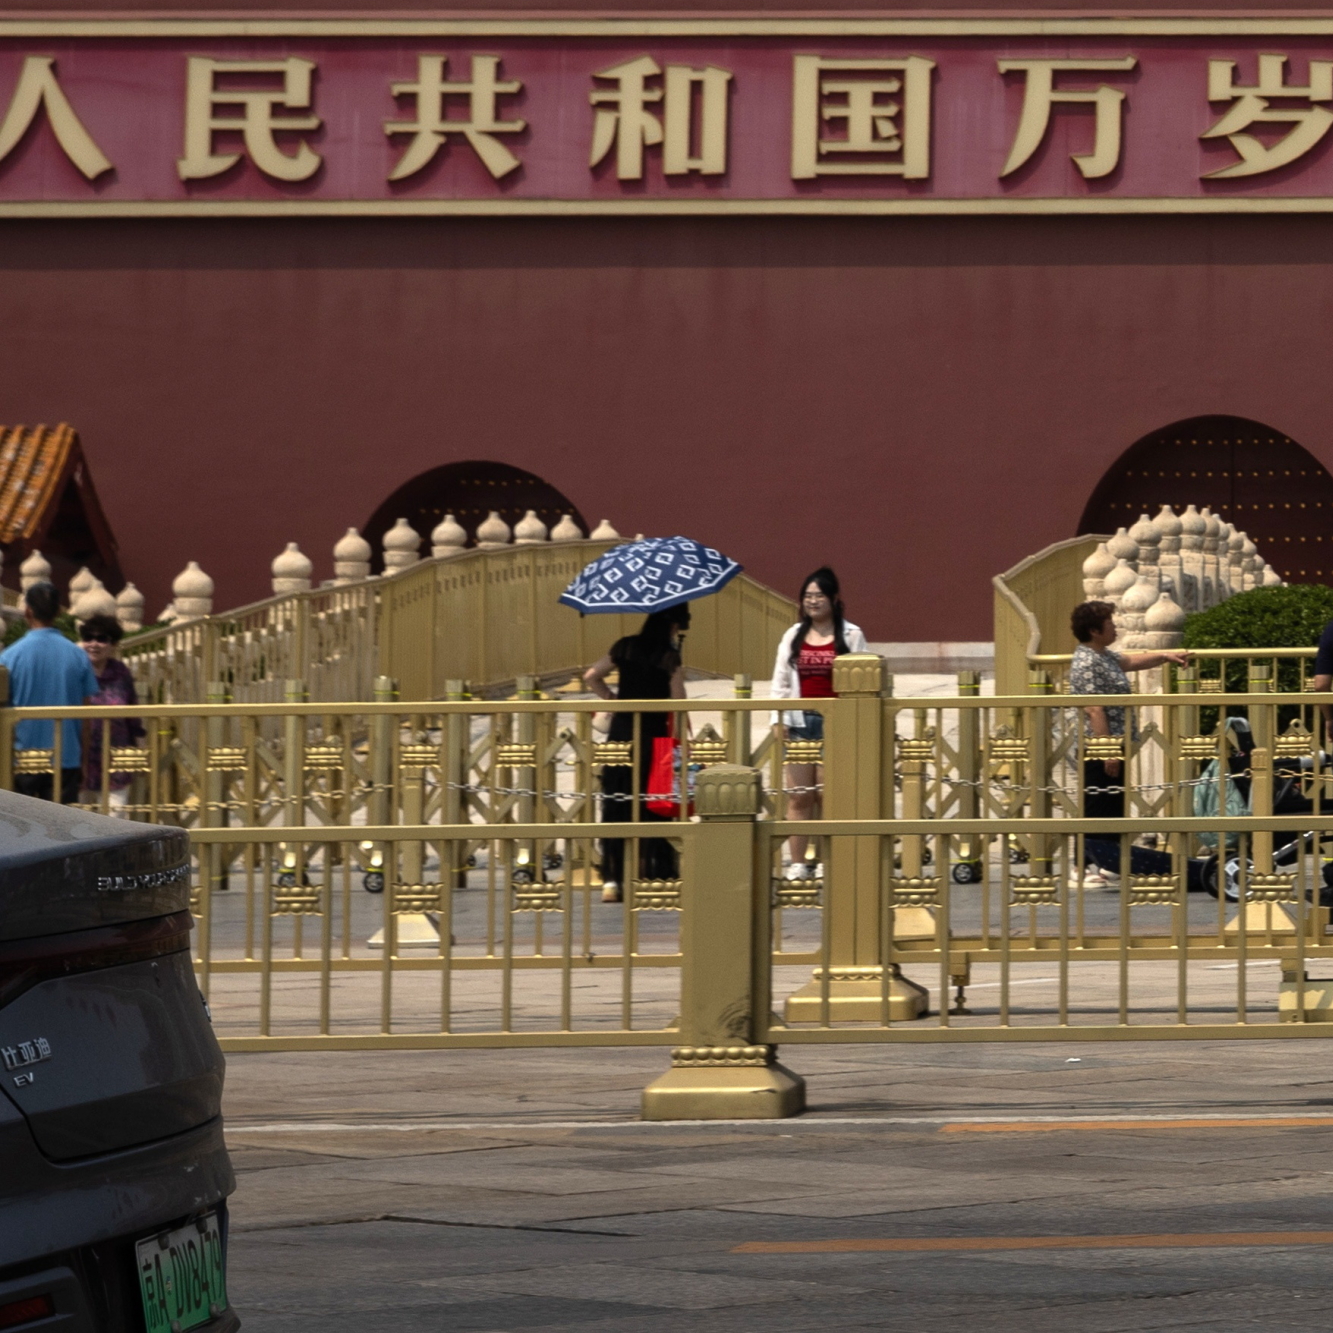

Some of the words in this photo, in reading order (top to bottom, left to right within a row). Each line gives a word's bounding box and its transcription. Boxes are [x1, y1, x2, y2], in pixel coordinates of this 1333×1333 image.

[1, 1037, 51, 1068] 比亚迪
[13, 1072, 34, 1087] EV
